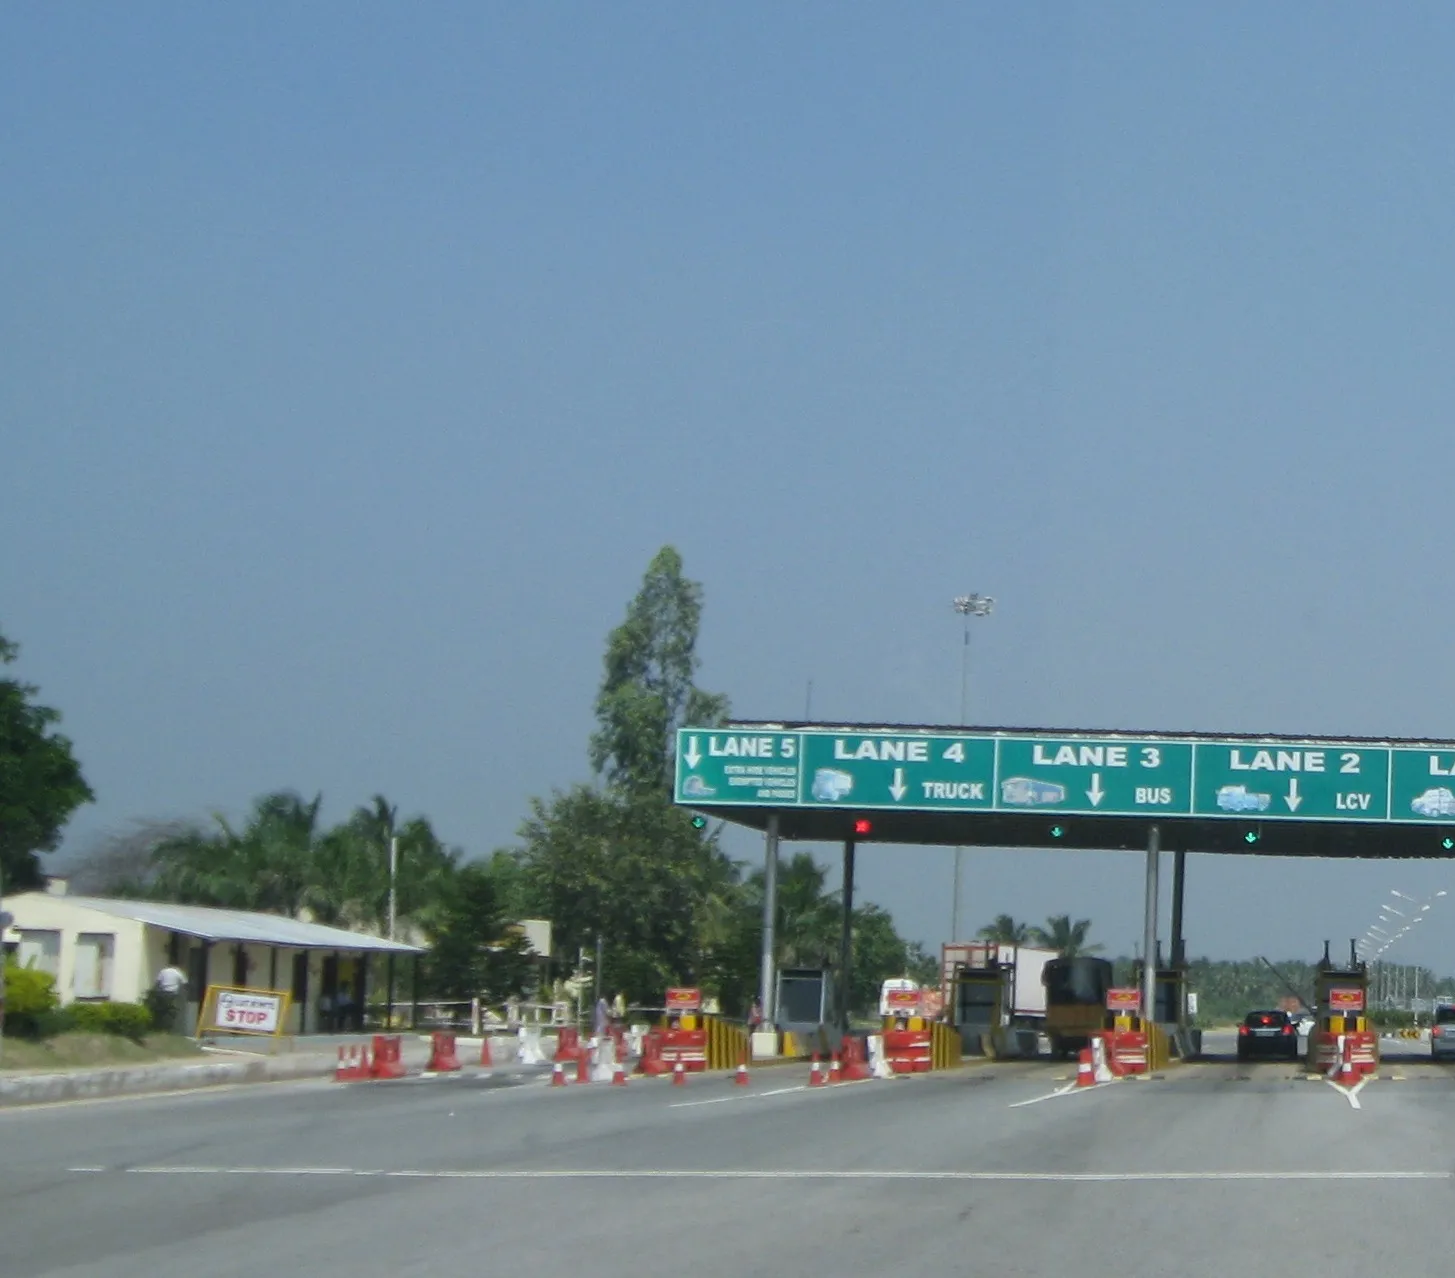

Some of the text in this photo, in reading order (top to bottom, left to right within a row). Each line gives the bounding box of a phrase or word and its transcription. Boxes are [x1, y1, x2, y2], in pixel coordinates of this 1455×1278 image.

[709, 737, 795, 757] LANE 5
[835, 740, 964, 762] LANE 4
[1033, 745, 1160, 767] LANE 3
[1231, 750, 1360, 773] LANE 2
[923, 782, 983, 799] TRUCK
[1136, 788, 1171, 804] BUS
[1337, 793, 1370, 809] LCV
[227, 1009, 267, 1023] STOP
